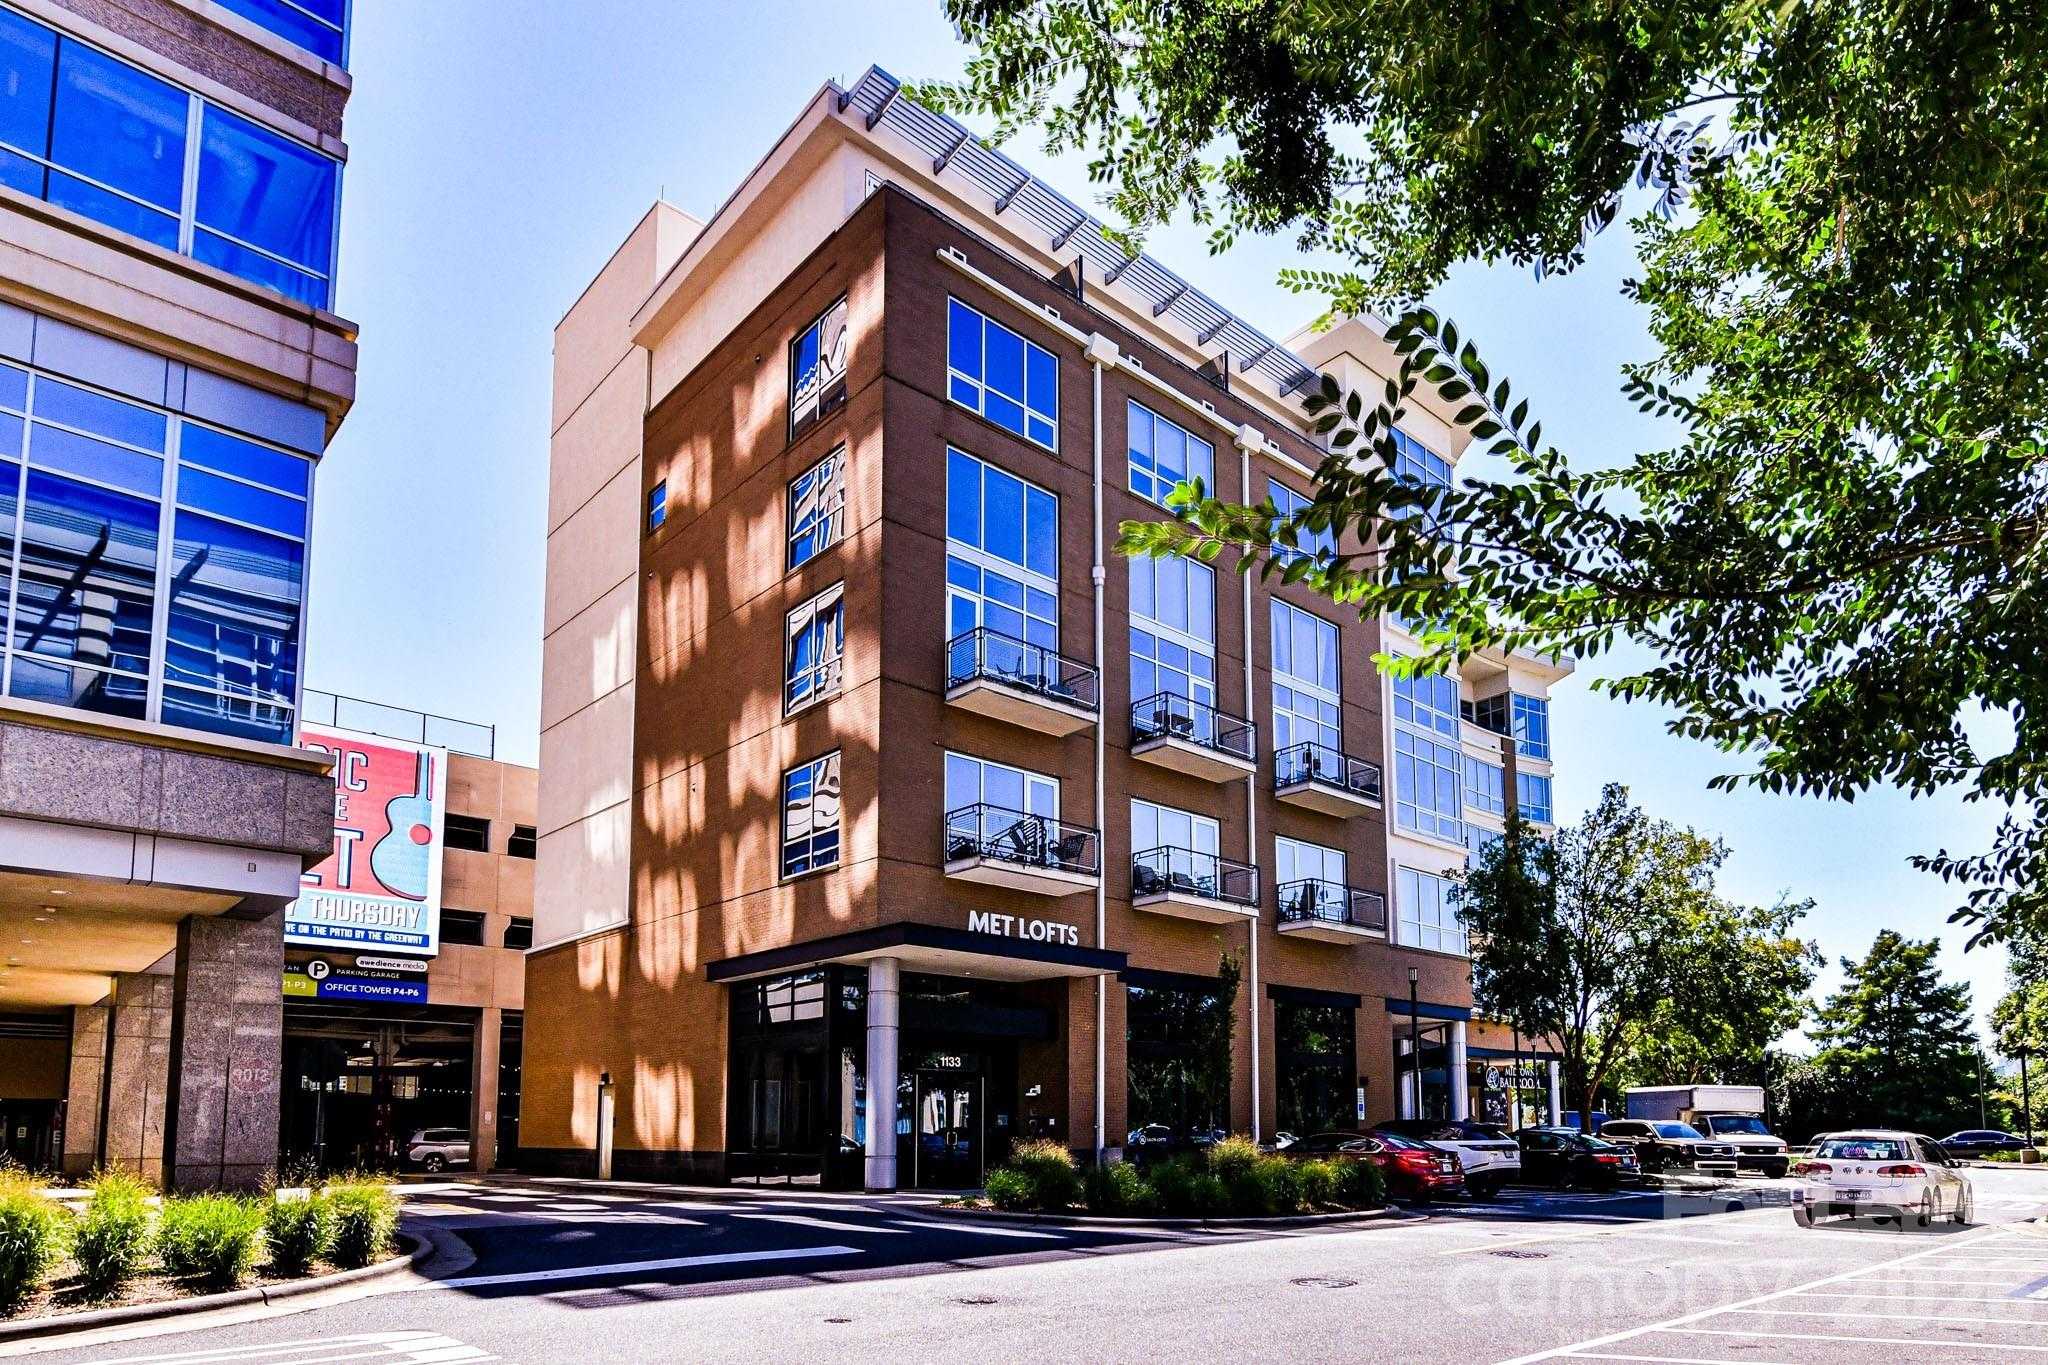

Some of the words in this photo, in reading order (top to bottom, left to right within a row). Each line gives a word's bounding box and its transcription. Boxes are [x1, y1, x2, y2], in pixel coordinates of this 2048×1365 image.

[311, 897, 422, 929] THURSDAY
[312, 925, 327, 936] THE
[329, 927, 353, 938] PATIO
[355, 930, 366, 939] BY
[368, 931, 382, 941] THE
[384, 932, 423, 945] GREENWAY
[968, 910, 1014, 937] MET
[1018, 917, 1078, 946] LOFTS
[360, 959, 401, 969] awedience
[336, 968, 369, 977] PARKING
[371, 971, 400, 979] GARAGE
[325, 982, 357, 993] OFFICE
[359, 984, 392, 995] TOWER
[393, 988, 420, 997] P4-P6
[940, 1056, 961, 1067] 1133
